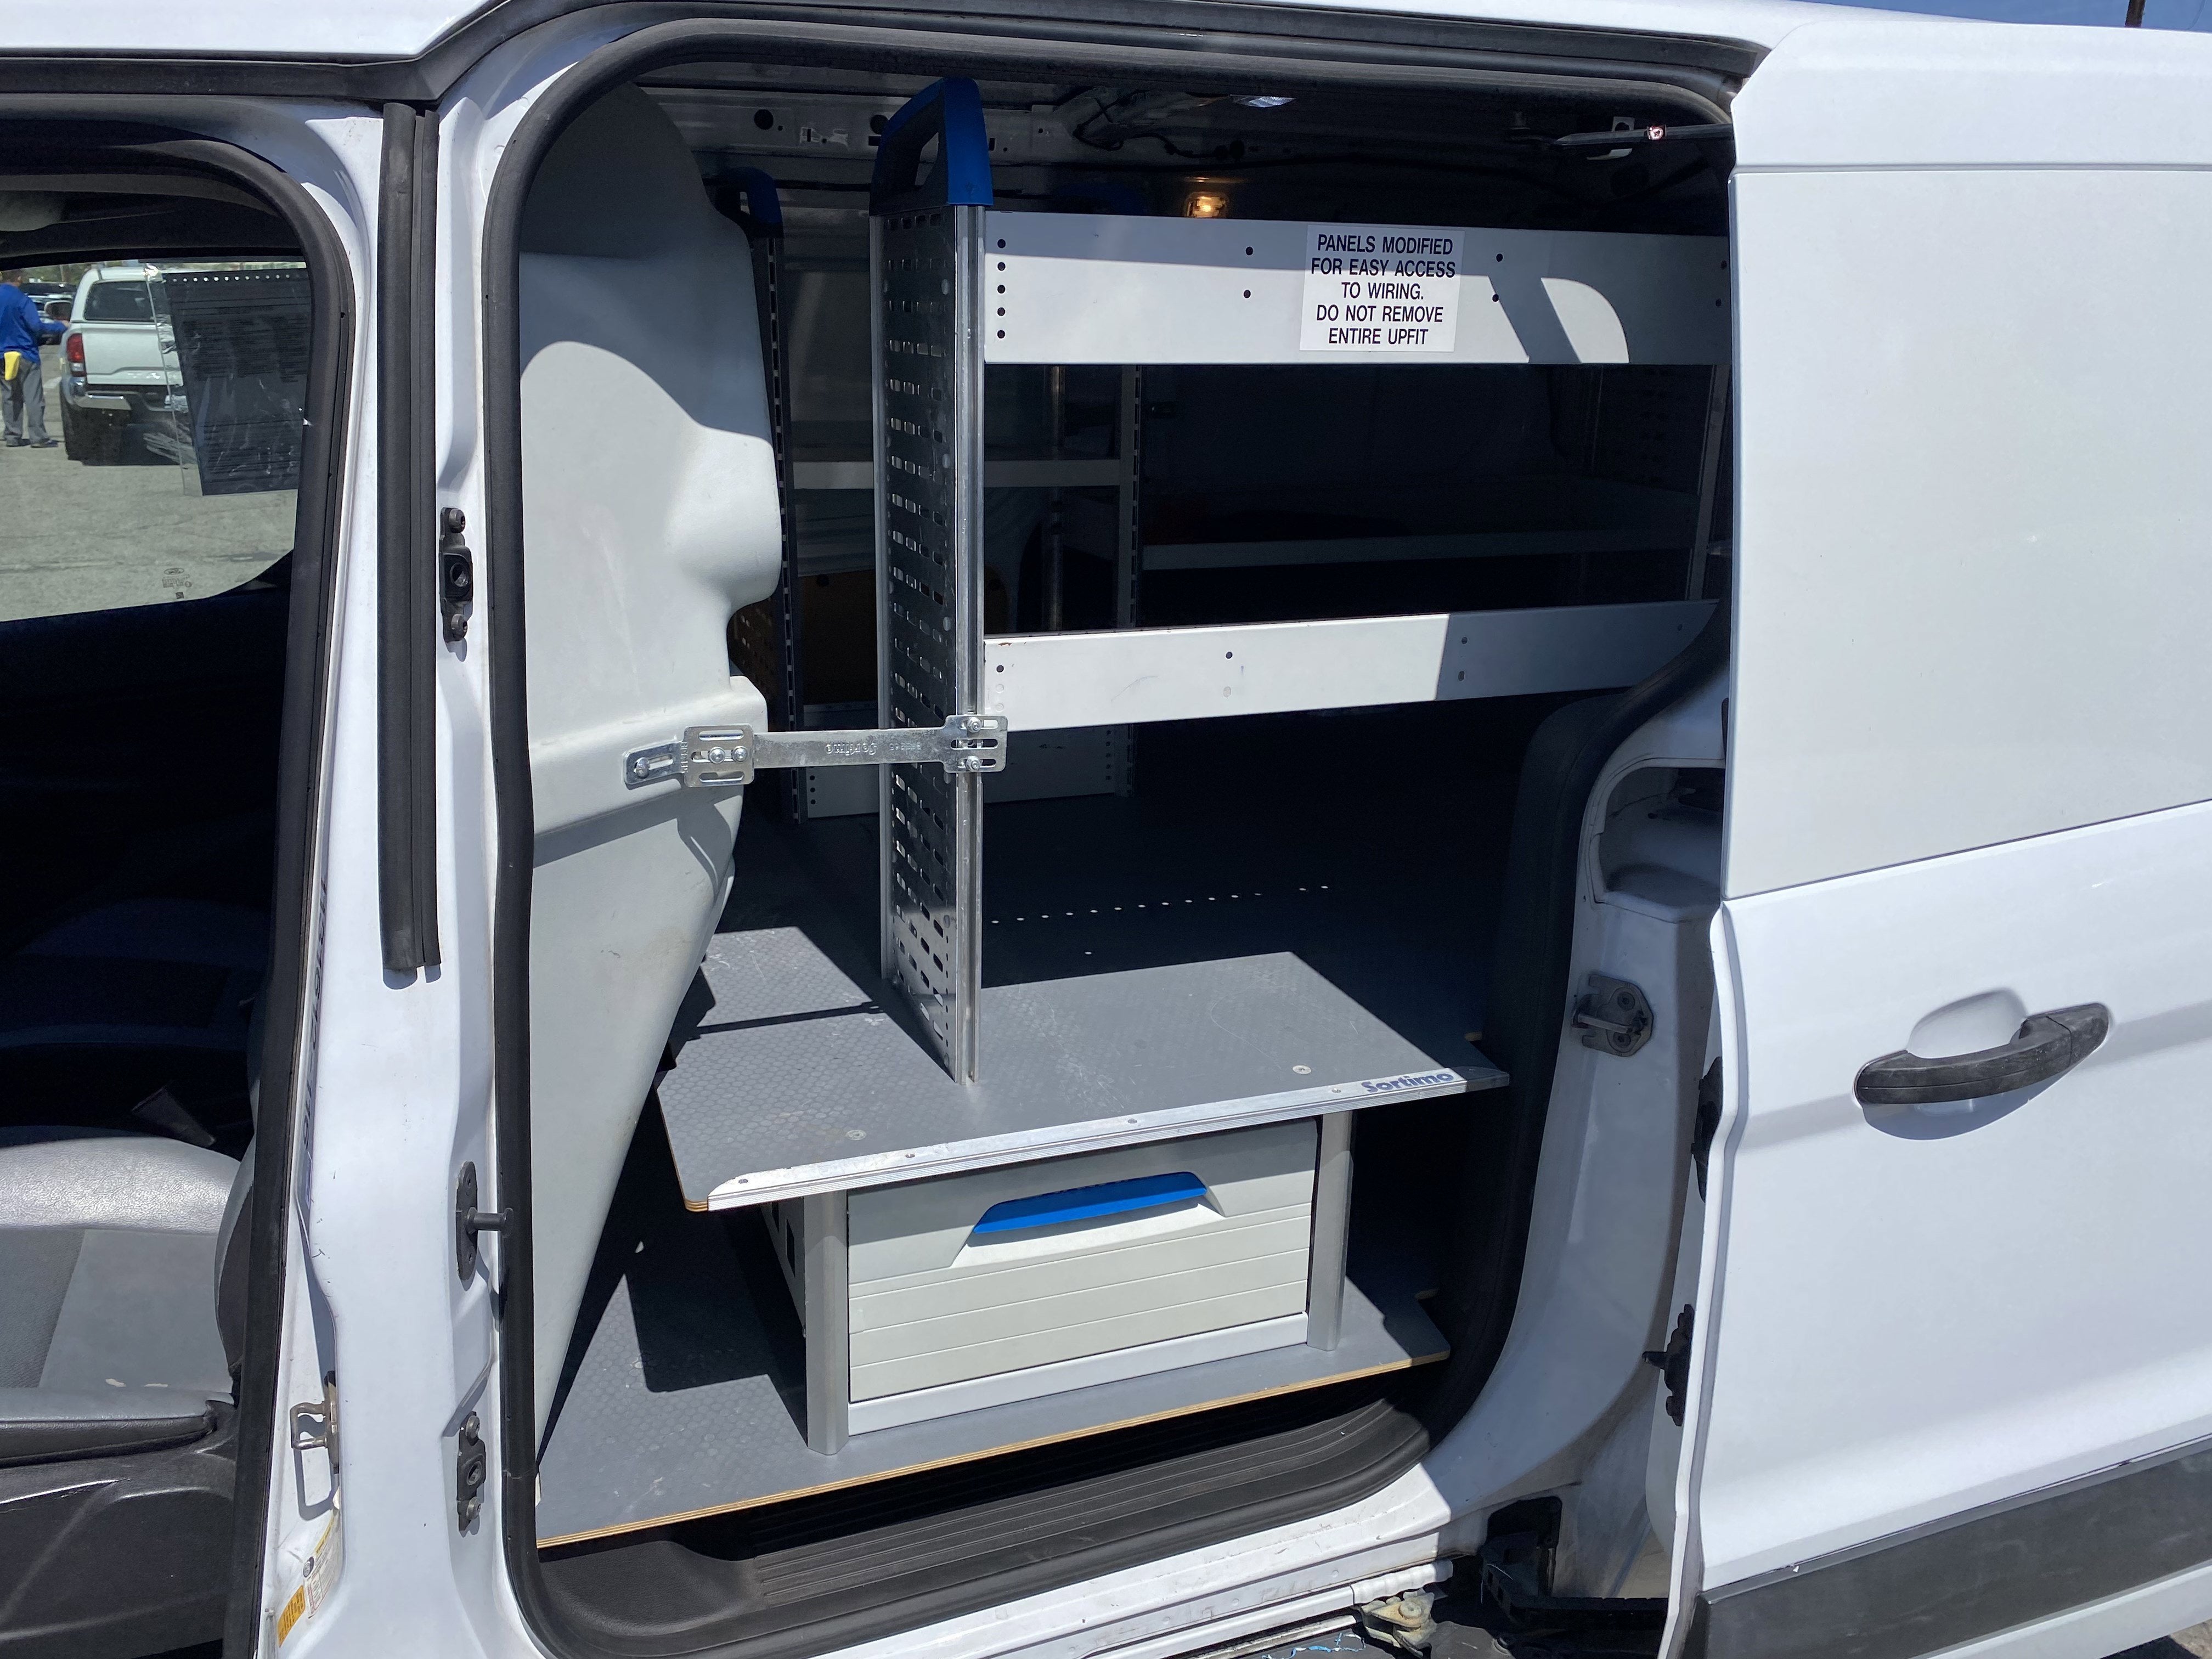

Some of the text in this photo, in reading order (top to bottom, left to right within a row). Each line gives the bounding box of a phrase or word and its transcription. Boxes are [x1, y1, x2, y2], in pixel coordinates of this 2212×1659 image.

[1318, 234, 1453, 255] PANELS MODIFIED
[1311, 257, 1455, 278] FOR EASY ACCESS
[1341, 282, 1424, 300] TO WIRING.
[1317, 304, 1443, 322] DO NOT REMOVE
[1329, 328, 1429, 344] ENTIRE UPFIT
[1361, 1073, 1454, 1093] Sortimo
